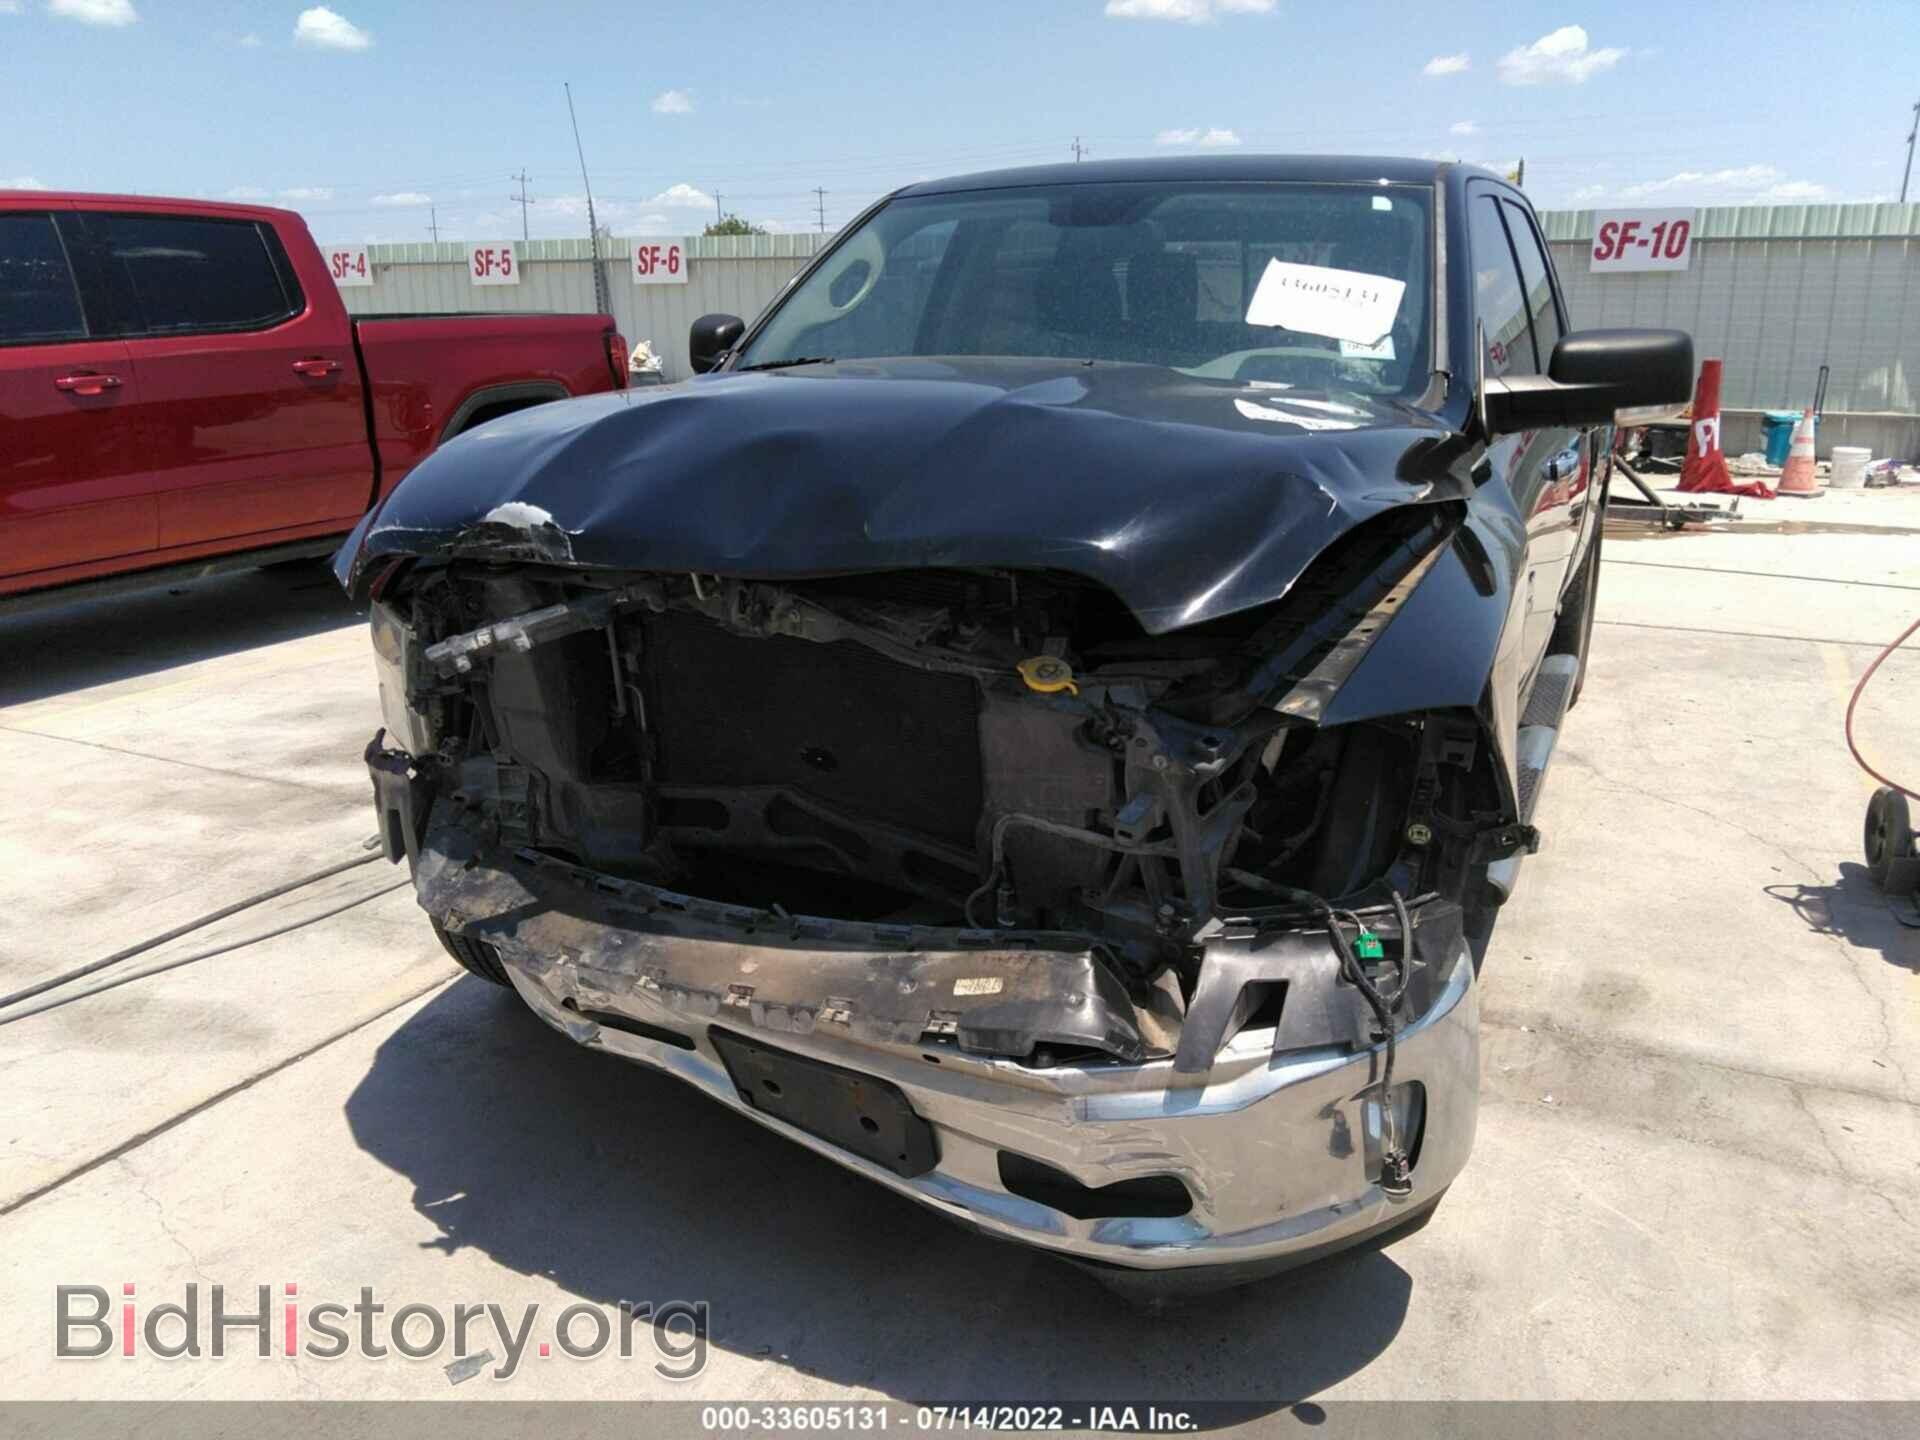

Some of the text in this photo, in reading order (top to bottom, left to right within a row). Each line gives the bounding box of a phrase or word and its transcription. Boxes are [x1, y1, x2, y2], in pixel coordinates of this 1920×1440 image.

[1594, 220, 1690, 260] SF-10
[333, 252, 366, 278] SF-4
[475, 249, 511, 277] SF-5
[638, 246, 679, 275] SF-6
